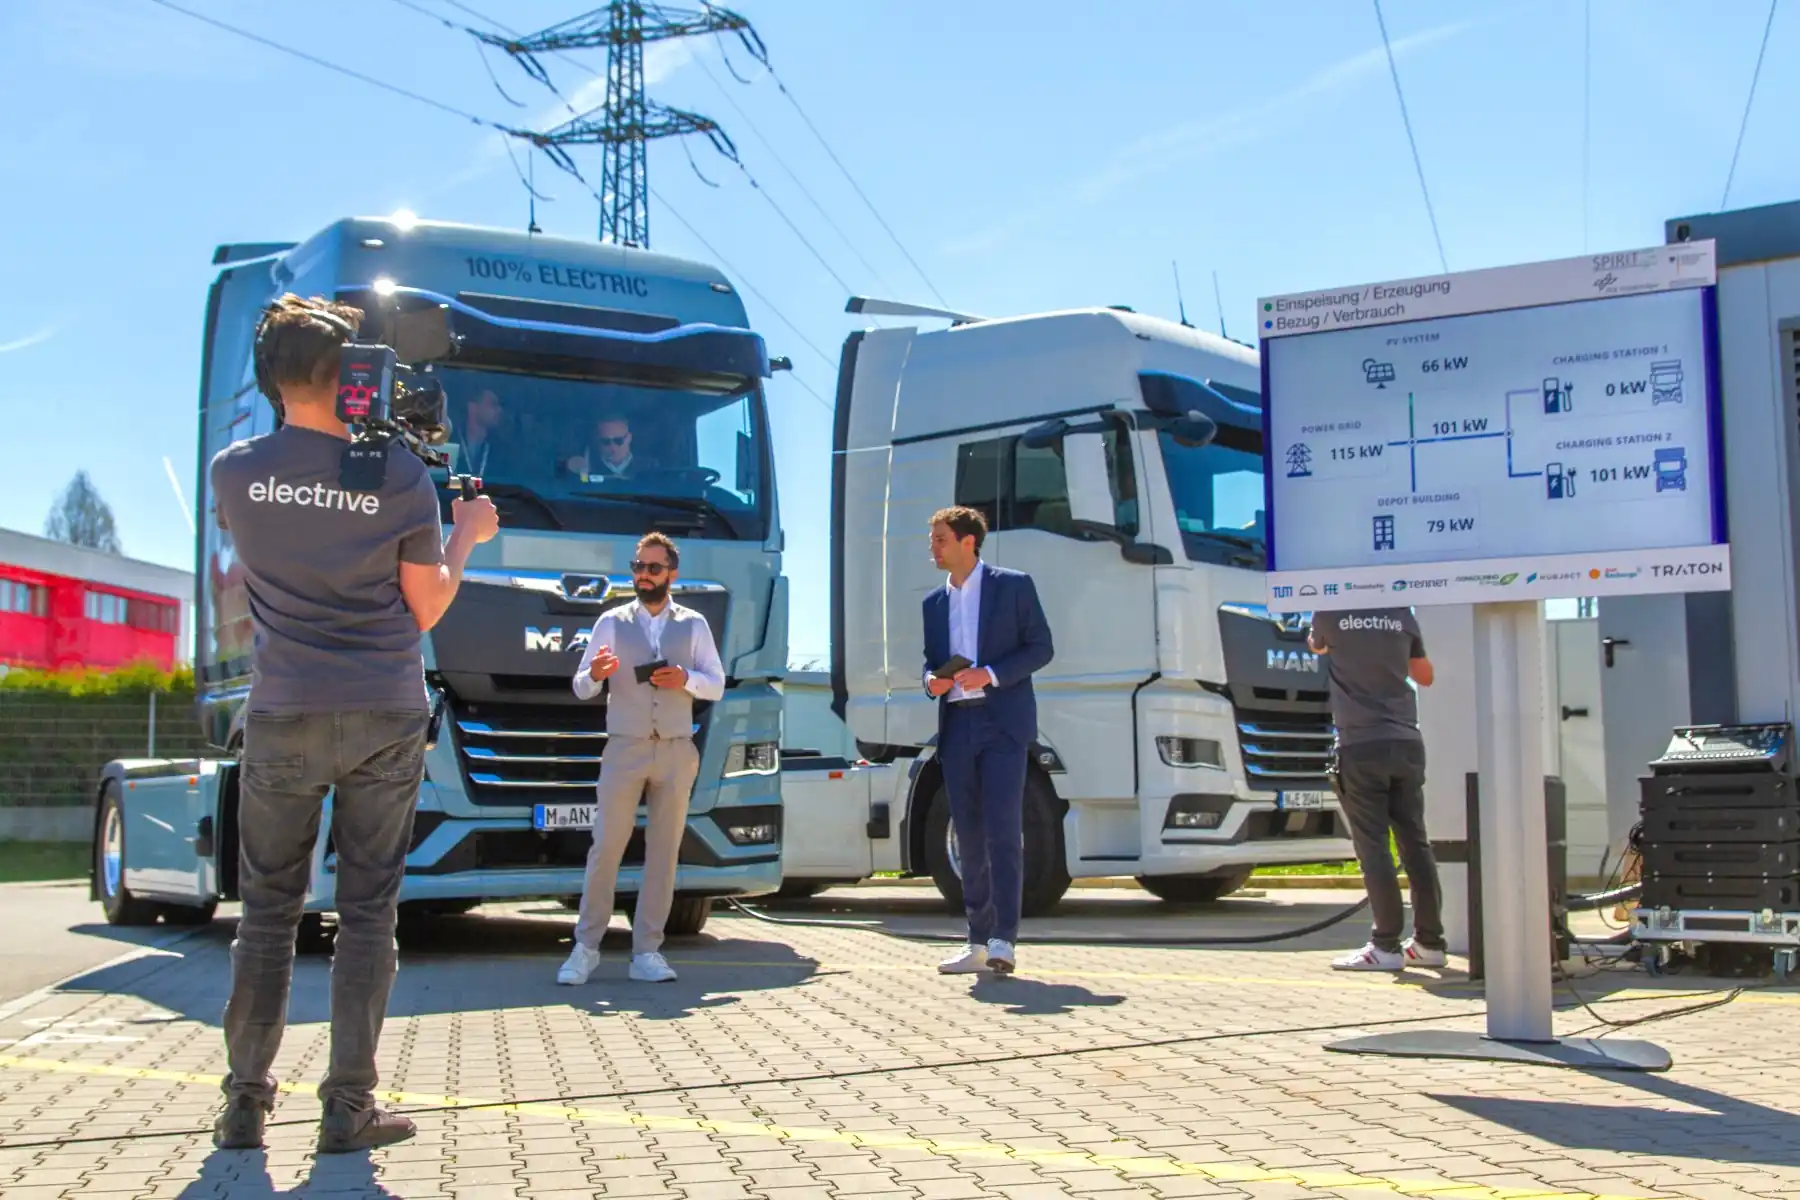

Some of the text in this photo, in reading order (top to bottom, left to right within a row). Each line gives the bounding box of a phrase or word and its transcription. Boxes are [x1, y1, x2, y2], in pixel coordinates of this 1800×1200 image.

[1592, 252, 1637, 271] SPIRIT
[465, 257, 648, 297] 100% ELECTRIC
[1276, 280, 1451, 312] Einspeisung / Erzeugung
[1276, 303, 1405, 330] Bezug / Verbrauch
[1386, 333, 1440, 346] PV SYSTEM
[1553, 344, 1668, 365] CHARGING STATION 1
[1422, 356, 1469, 373] 66 kW
[1605, 380, 1647, 396] 0 kW
[1302, 421, 1361, 434] POWER GRID
[1432, 418, 1488, 435] 101 kW
[1556, 432, 1672, 450] CHARGING STATION 2
[1331, 445, 1383, 460] 115 kW
[1590, 465, 1650, 482] 101 kW
[248, 476, 379, 514] electrive
[1377, 493, 1460, 507] DEPOT BUILDING
[1427, 518, 1475, 533] 79 kW
[1651, 562, 1723, 577] TRATON
[1339, 614, 1402, 632] electrive
[525, 626, 594, 652] MA
[1266, 649, 1319, 673] MAN
